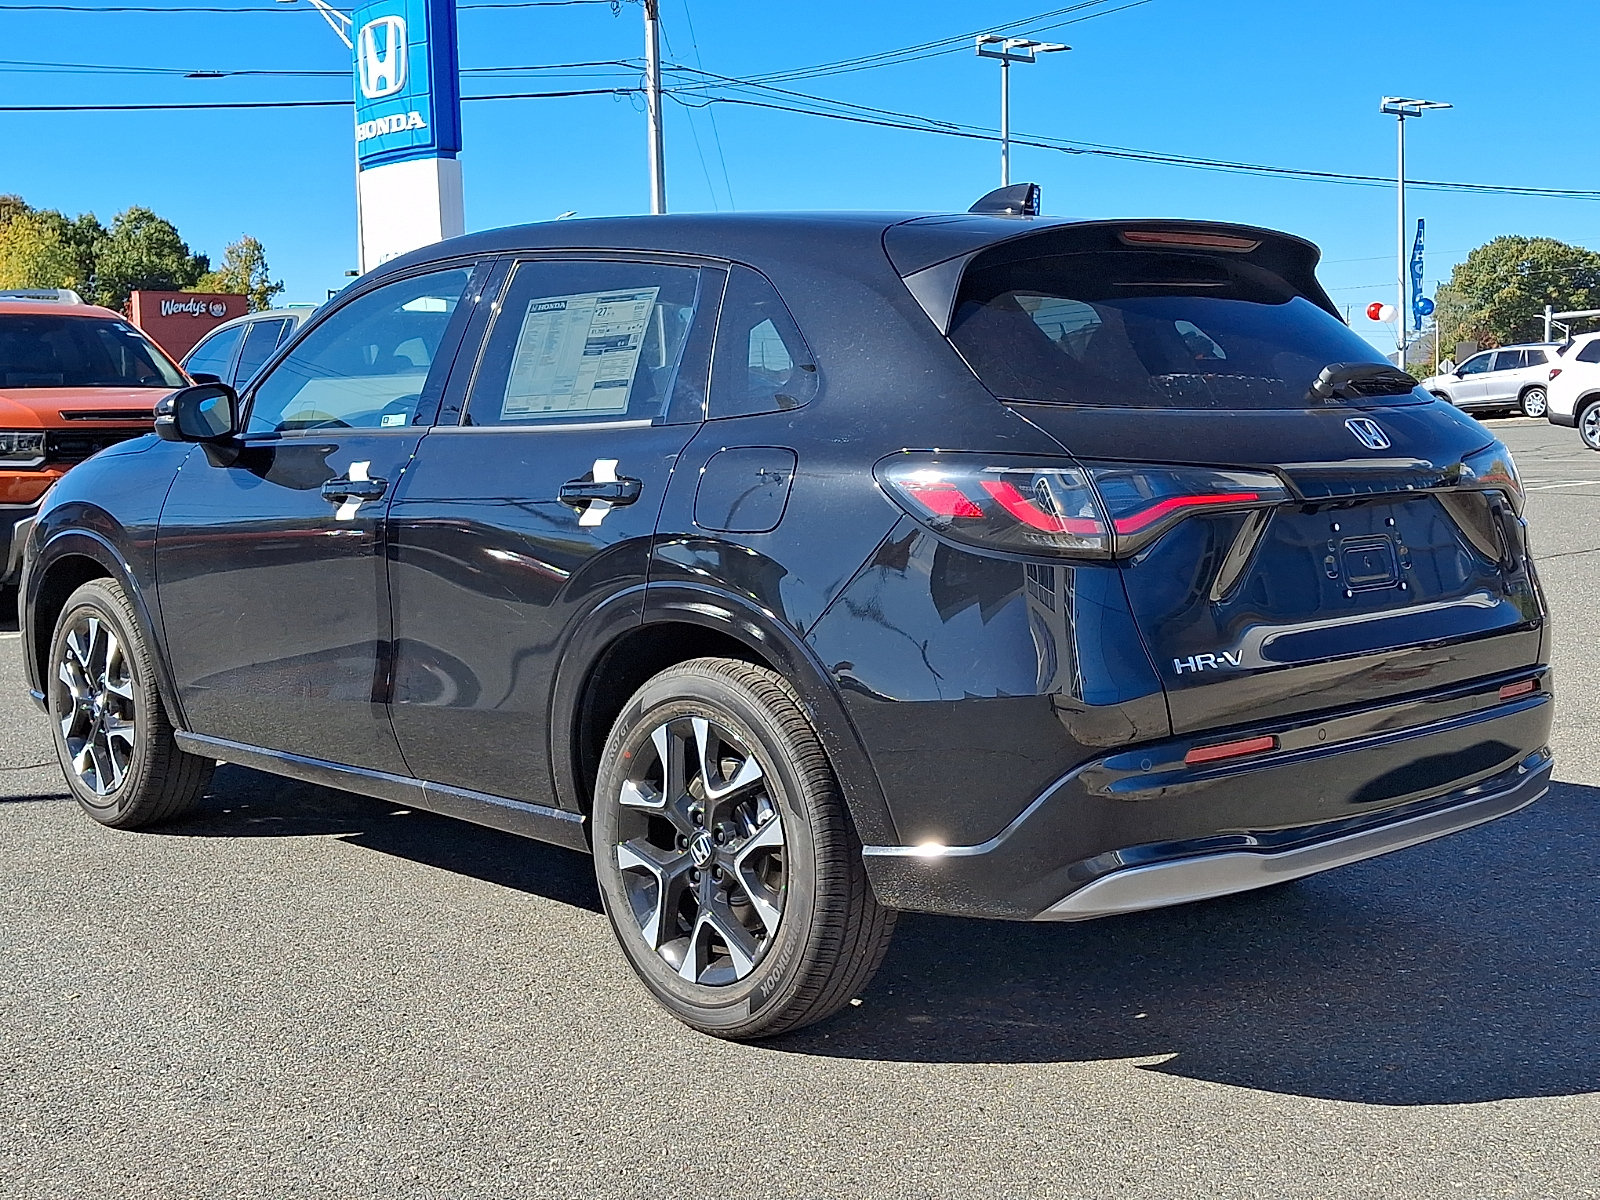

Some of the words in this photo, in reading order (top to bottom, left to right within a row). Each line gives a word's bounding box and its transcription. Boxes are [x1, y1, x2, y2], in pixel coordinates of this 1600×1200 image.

[357, 110, 427, 141] HONDA
[161, 298, 206, 316] Wendy's
[537, 302, 566, 311] HONDA
[597, 306, 608, 317] 27
[1173, 649, 1243, 674] HR-V
